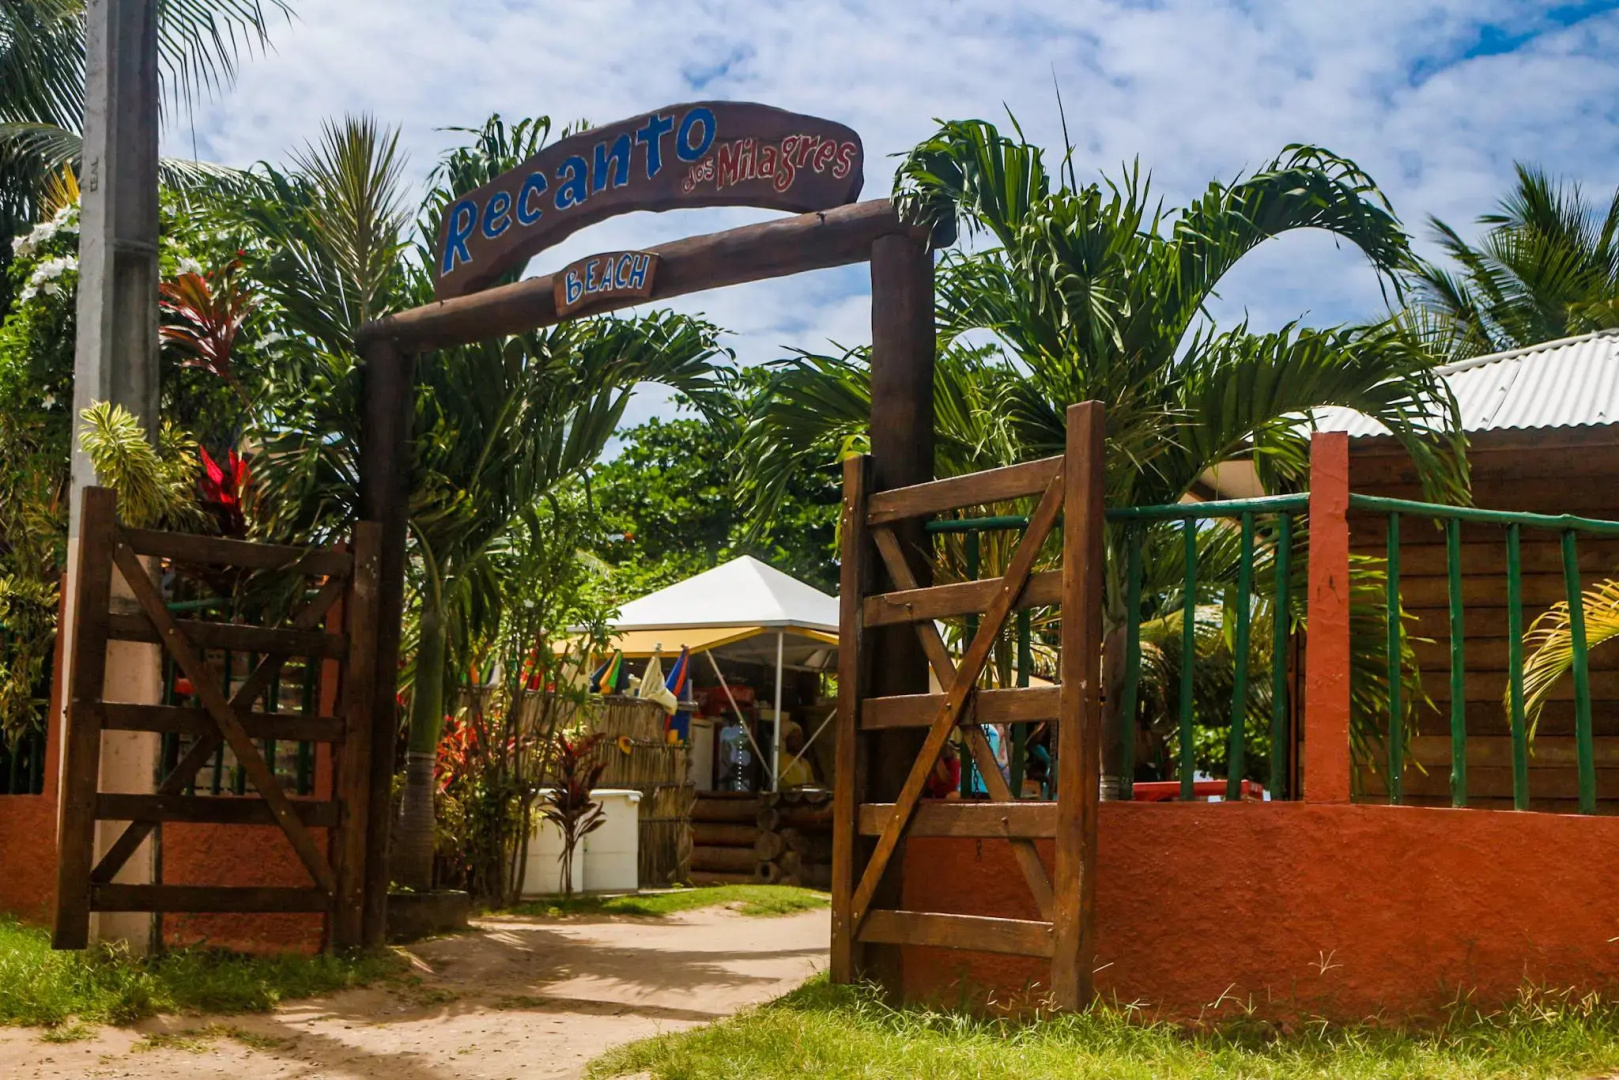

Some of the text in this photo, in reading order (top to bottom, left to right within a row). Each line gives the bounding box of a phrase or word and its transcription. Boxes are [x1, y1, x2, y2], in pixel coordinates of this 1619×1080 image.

[440, 106, 718, 277] Recanto
[682, 134, 857, 194] dos Milagres
[564, 253, 650, 306] BEACH
